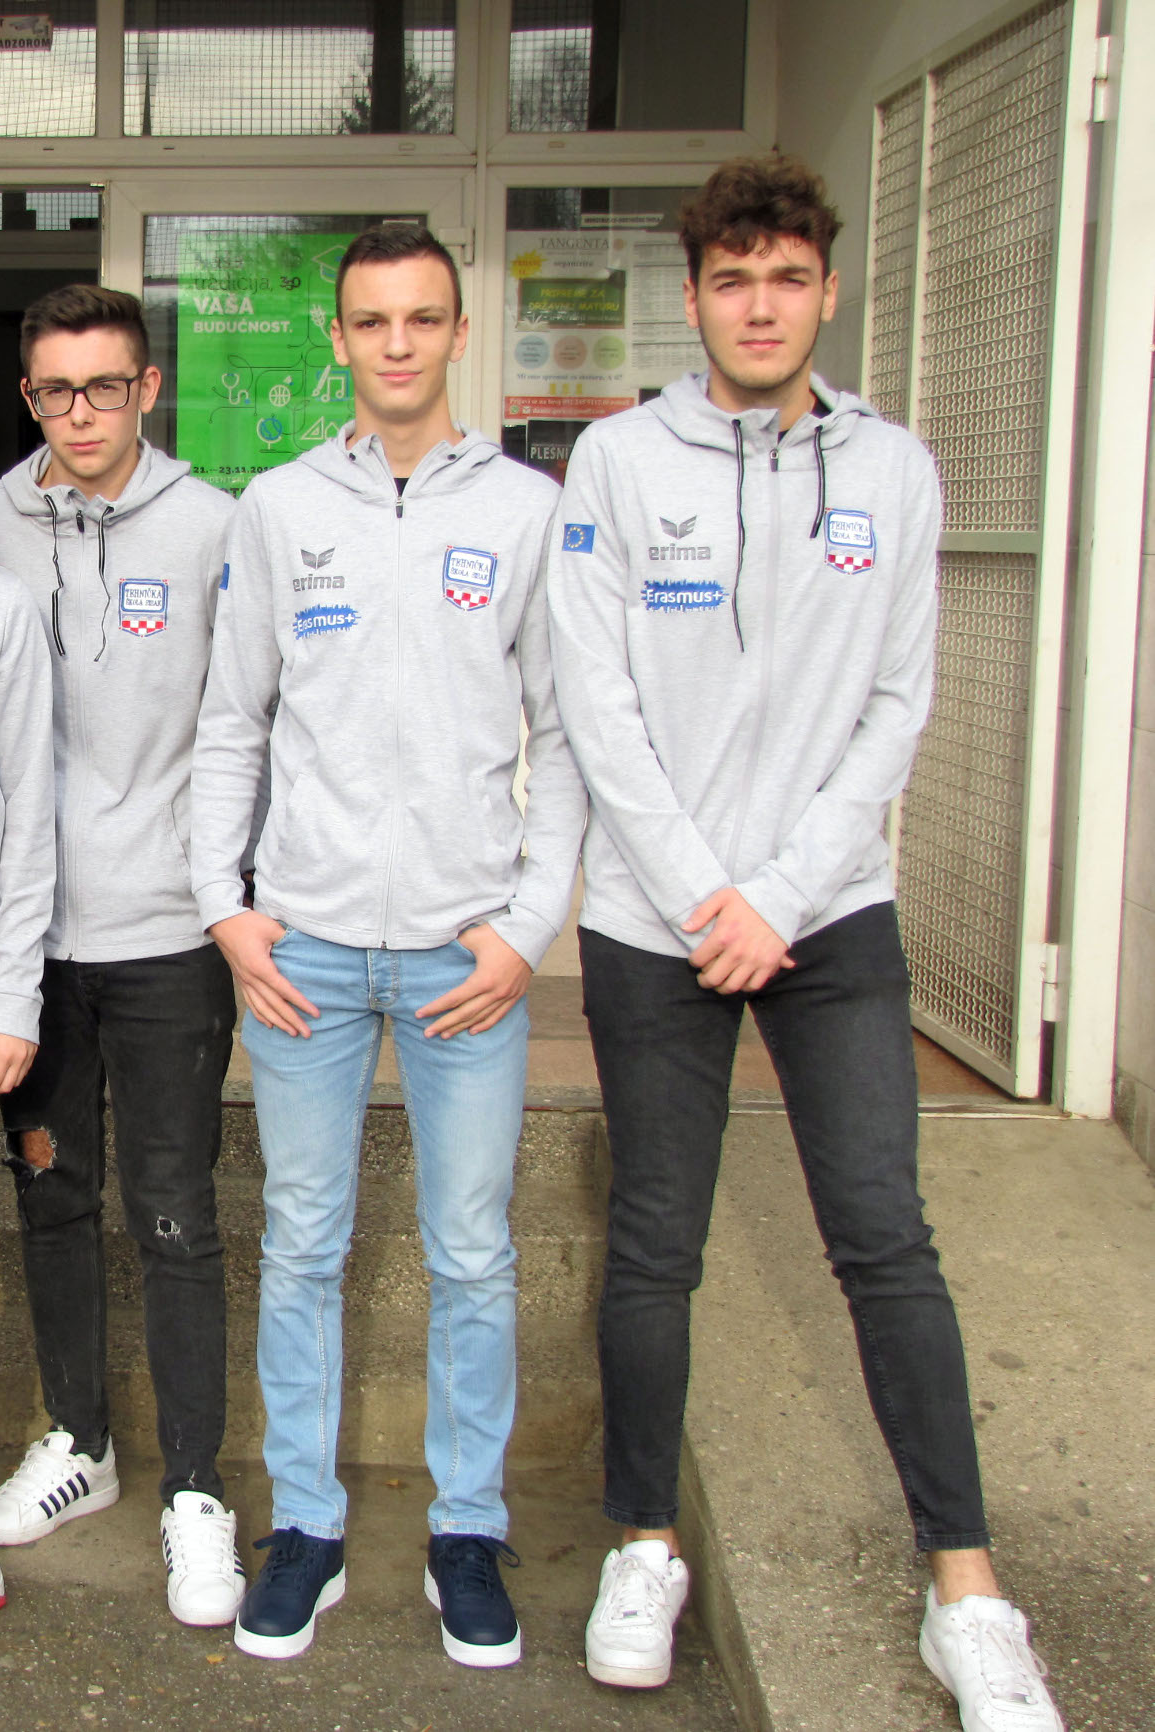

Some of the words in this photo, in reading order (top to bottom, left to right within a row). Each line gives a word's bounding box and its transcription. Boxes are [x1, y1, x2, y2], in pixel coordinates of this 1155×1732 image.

[539, 237, 609, 249] TANGENTA
[193, 293, 254, 315] VAŠA
[193, 319, 293, 333] BUDUĆNOST.
[648, 543, 711, 561] erima
[292, 573, 345, 592] erima
[646, 589, 723, 604] Erasmus+
